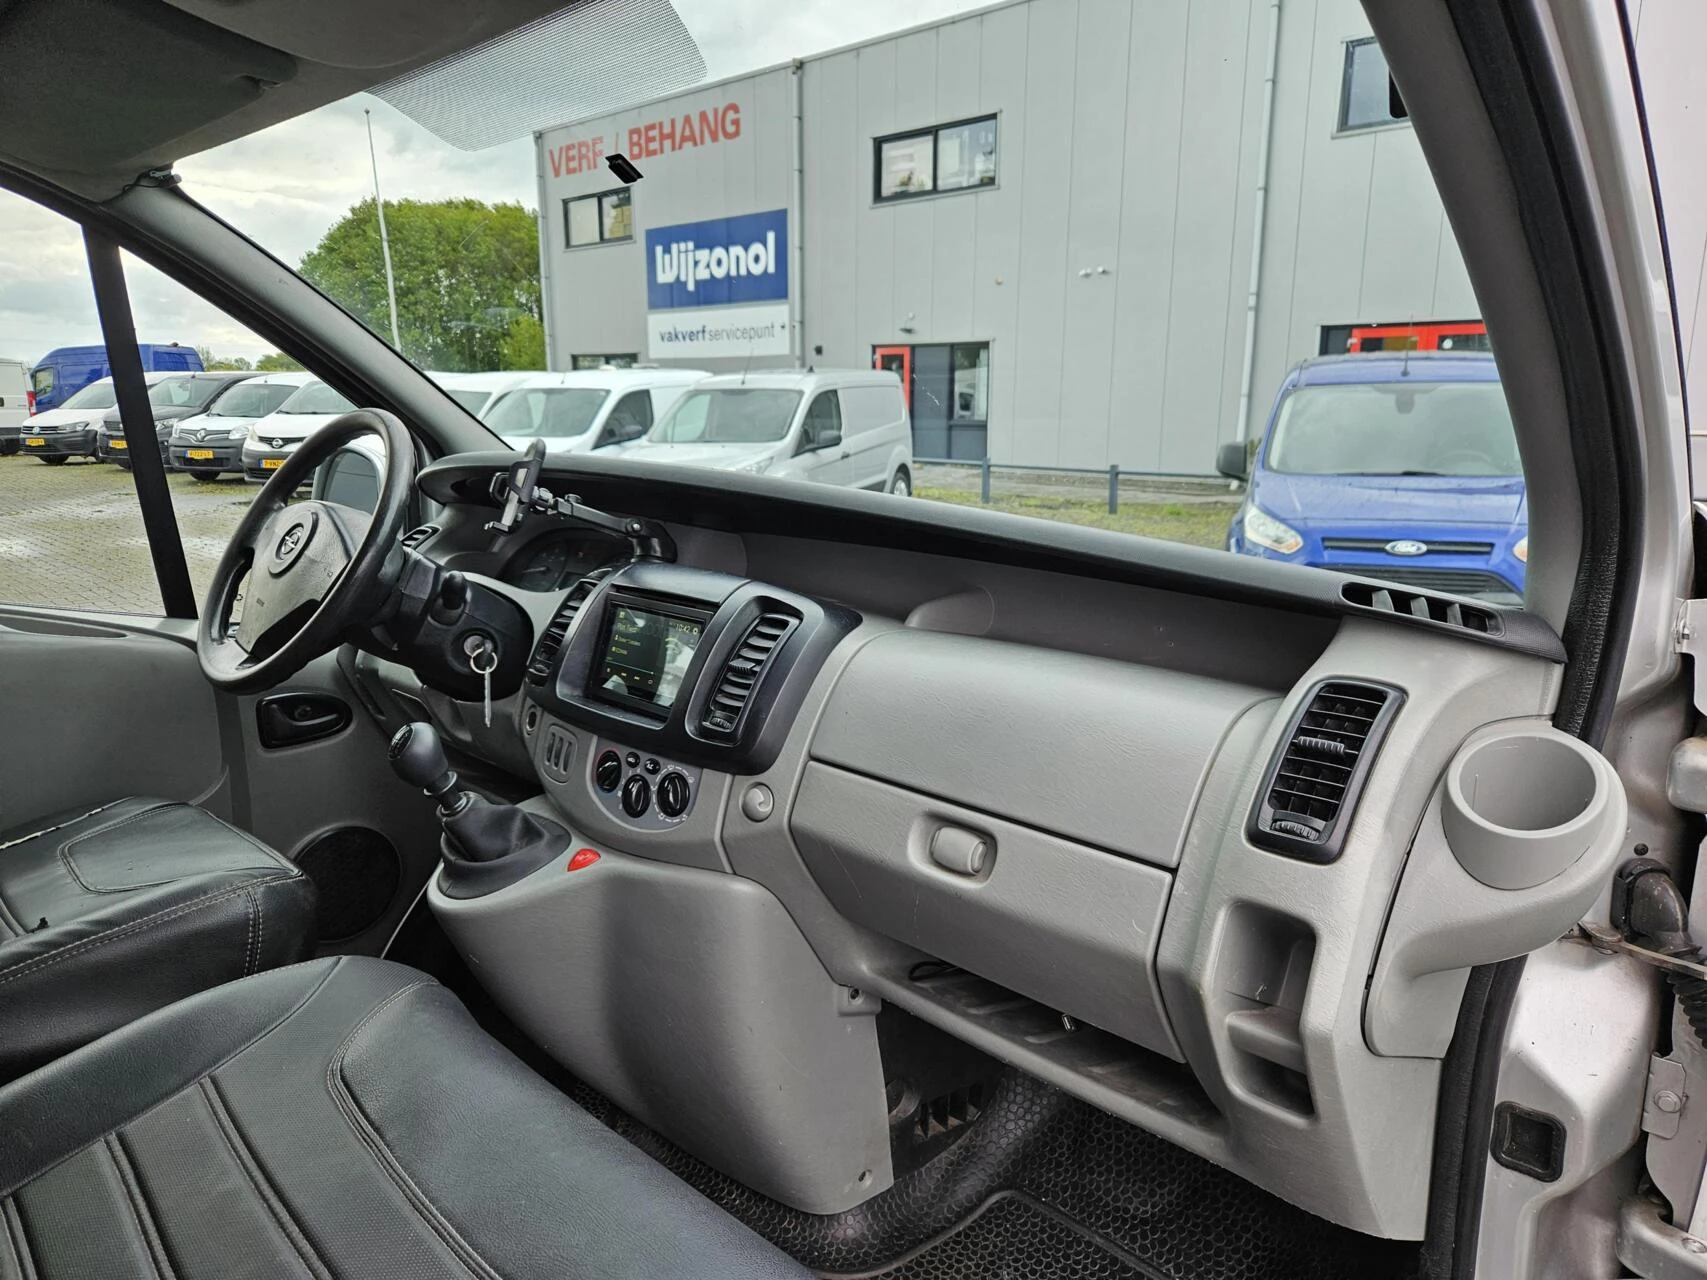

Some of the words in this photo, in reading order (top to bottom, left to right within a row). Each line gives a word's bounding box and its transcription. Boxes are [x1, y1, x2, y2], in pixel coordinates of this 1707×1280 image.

[549, 136, 605, 178] VERF
[627, 102, 742, 162] BEHANG
[654, 230, 776, 292] Wijzonol
